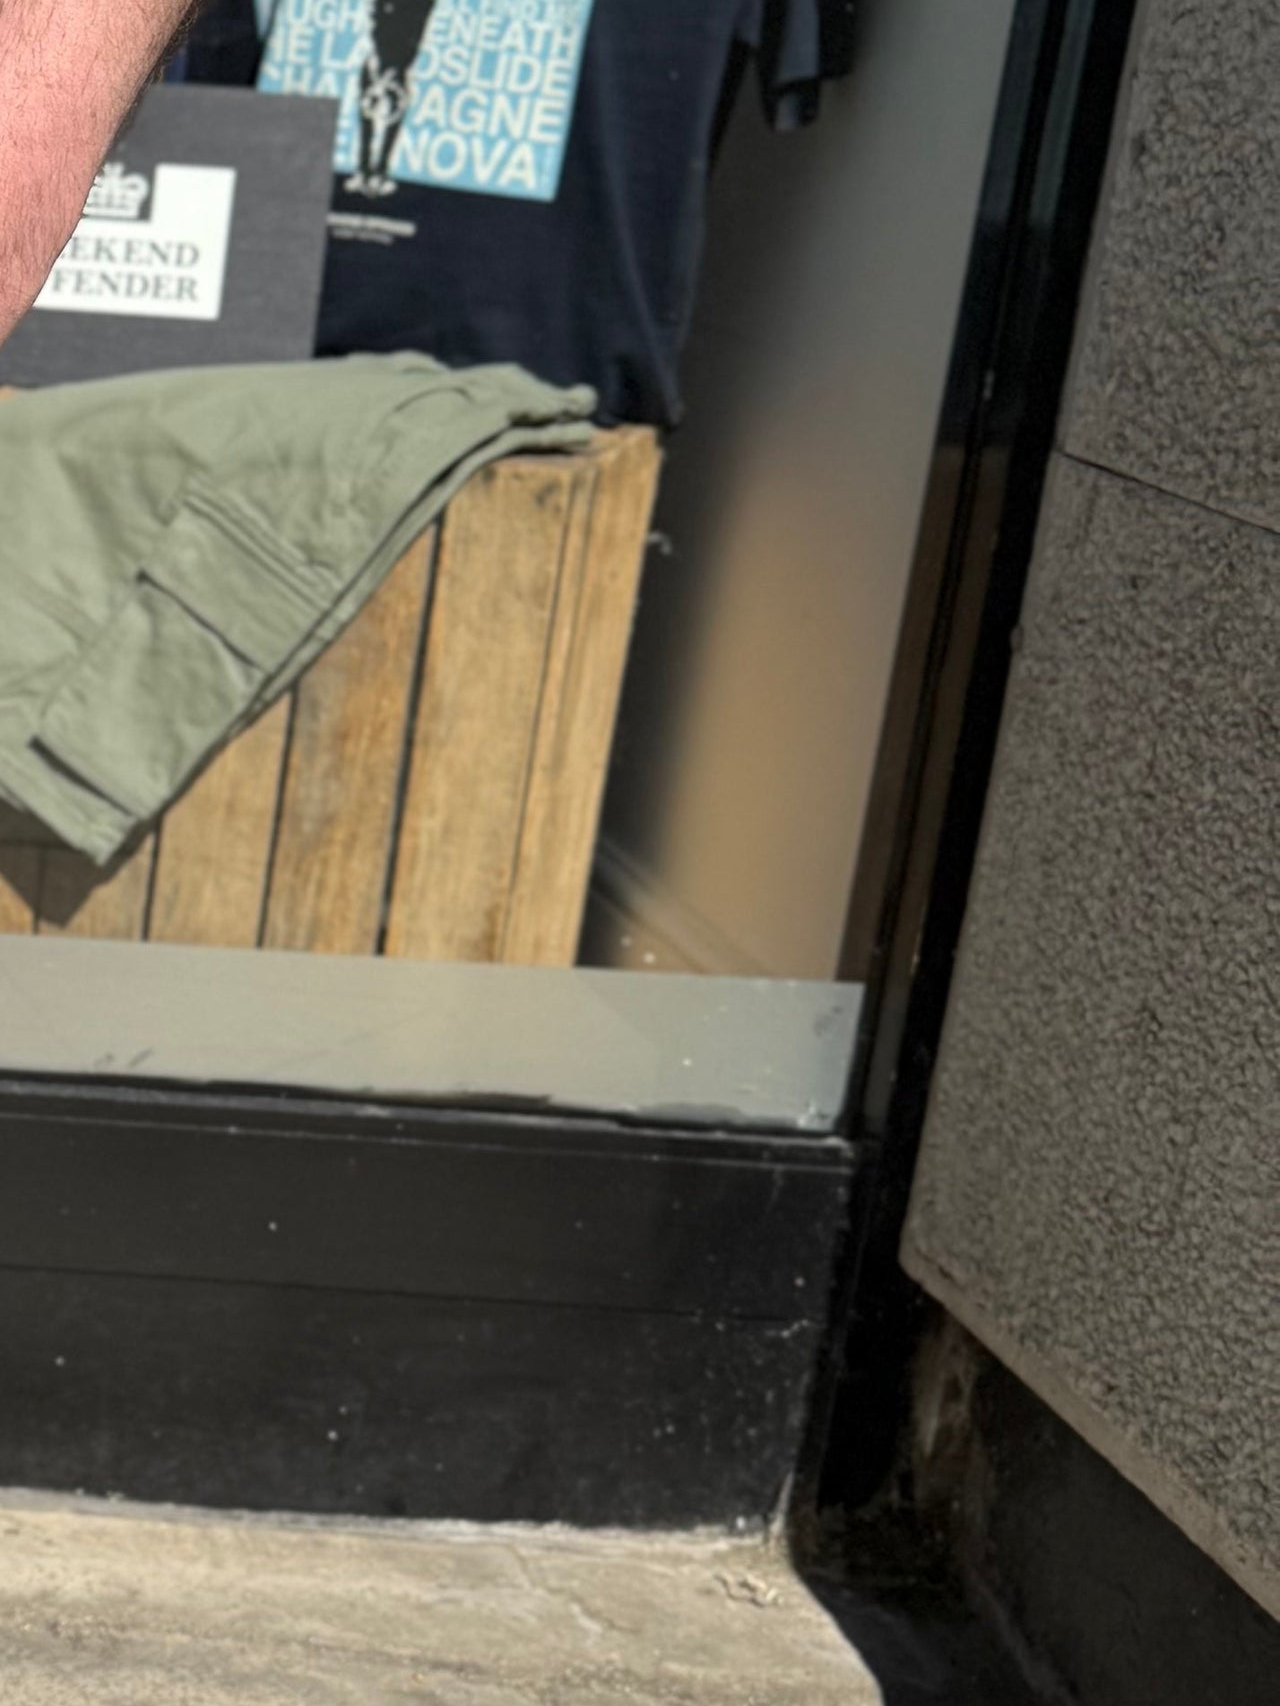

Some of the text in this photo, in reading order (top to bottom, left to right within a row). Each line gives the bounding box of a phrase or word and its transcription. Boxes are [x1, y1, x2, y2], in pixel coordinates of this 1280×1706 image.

[430, 12, 577, 60] ENEATH
[320, 31, 577, 96] LADSLIDE
[68, 235, 200, 268] EKEND
[51, 268, 199, 303] FENDER
